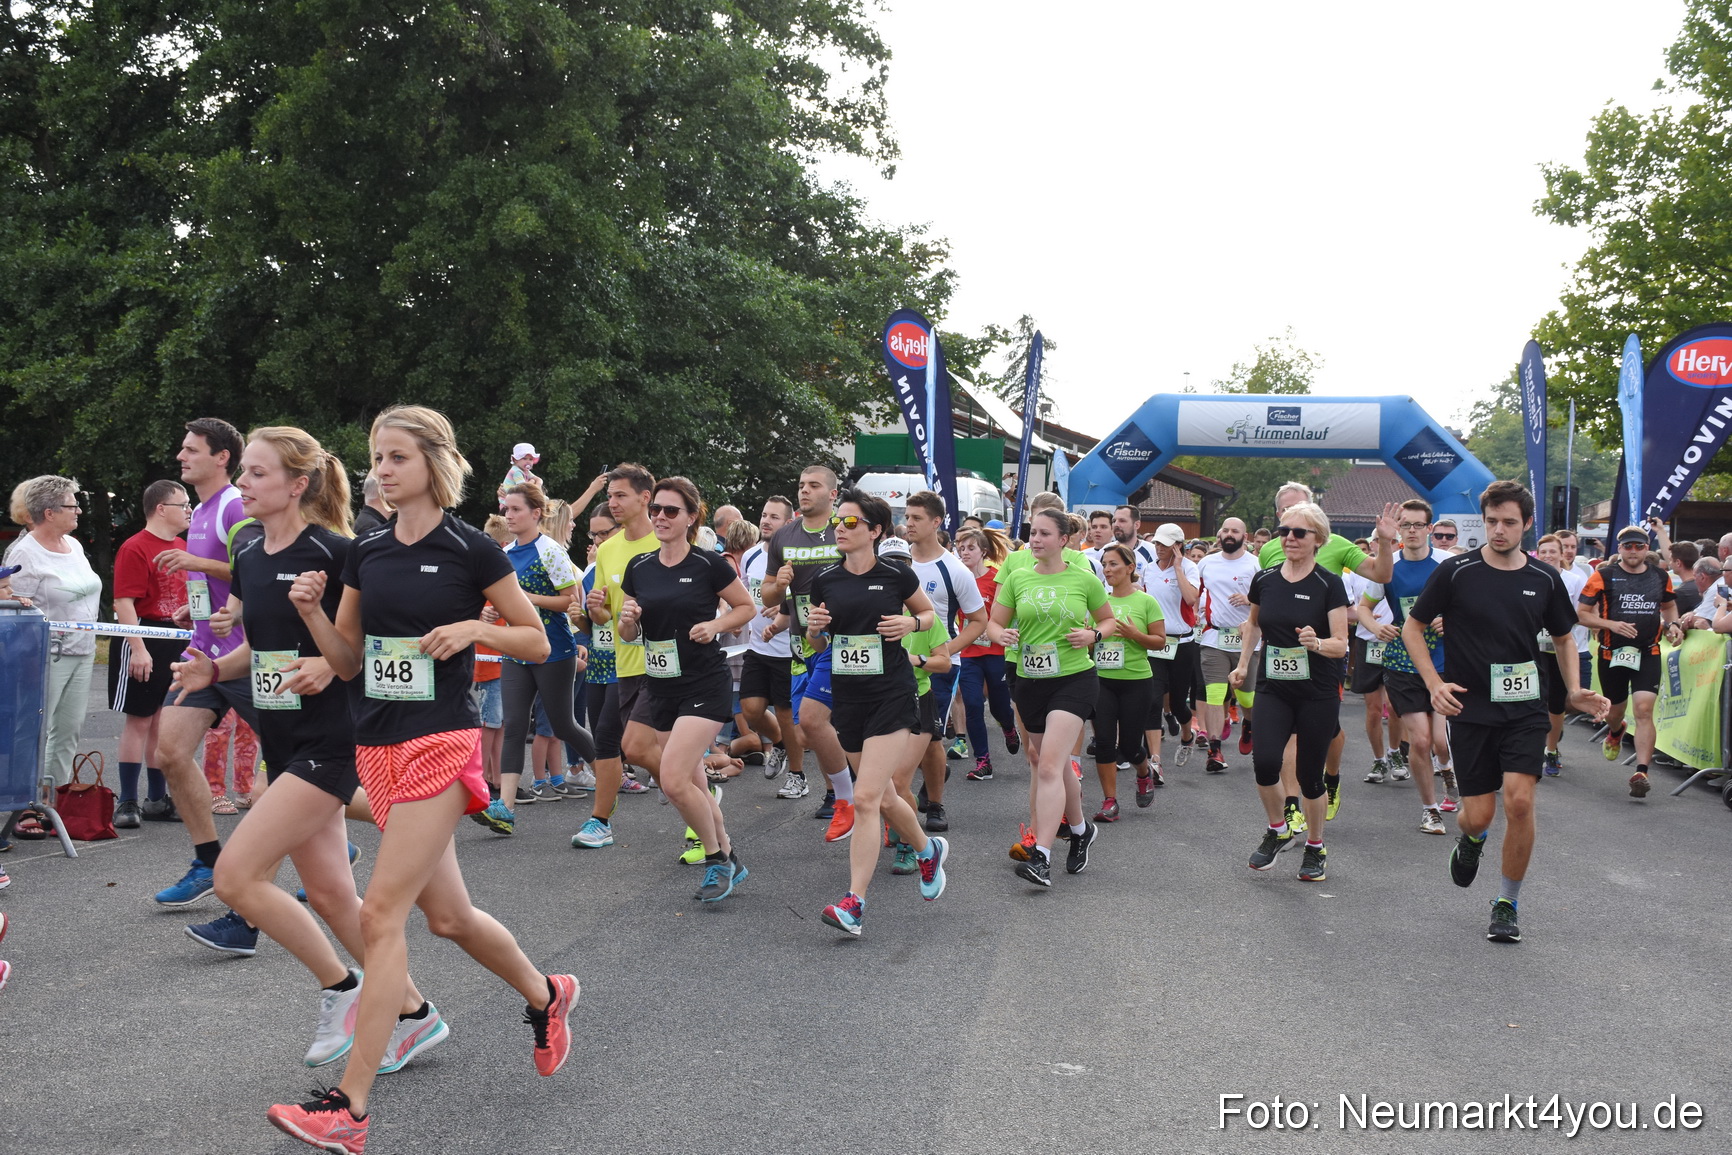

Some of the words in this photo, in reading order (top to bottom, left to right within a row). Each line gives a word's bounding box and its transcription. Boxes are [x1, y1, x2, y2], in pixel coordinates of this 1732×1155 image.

[1254, 426, 1330, 440] firmenlauf
[1113, 447, 1153, 457] Fischer
[784, 546, 839, 559] BOCK
[1619, 593, 1646, 602] HECK
[1620, 601, 1658, 610] DESIGN
[840, 649, 870, 664] 945
[1024, 655, 1052, 668] 2421
[1096, 651, 1120, 662] 2422
[1614, 653, 1637, 664] 1021
[373, 659, 414, 683] 948
[1273, 659, 1299, 671] 953
[255, 672, 283, 694] 952
[387, 682, 413, 690] Veronika
[1503, 676, 1530, 692] 951
